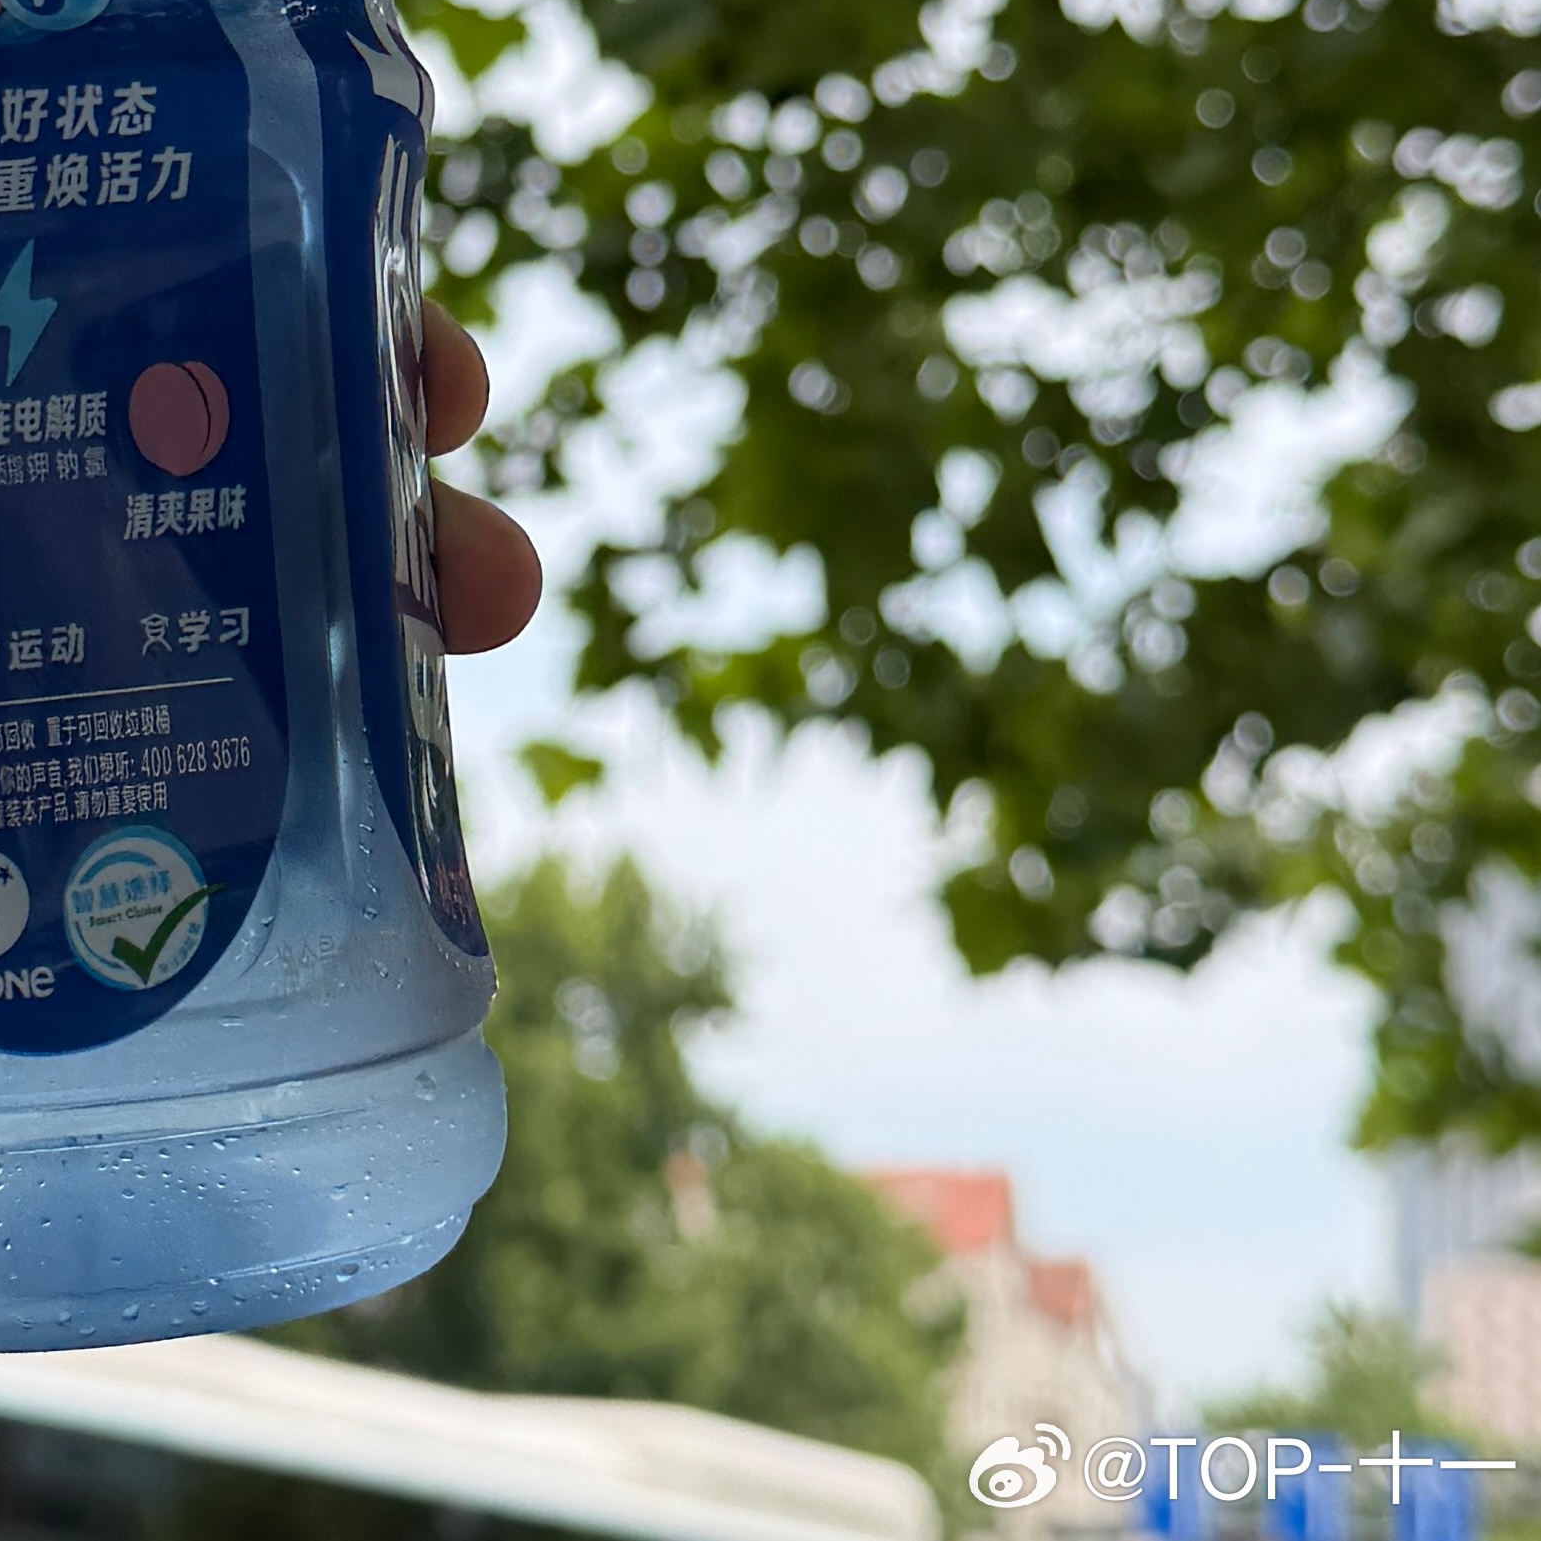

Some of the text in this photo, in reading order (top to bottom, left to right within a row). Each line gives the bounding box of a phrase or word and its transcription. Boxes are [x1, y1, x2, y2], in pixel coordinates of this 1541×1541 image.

[124, 484, 248, 541] 清爽果味
[9, 623, 86, 671] 运动
[178, 606, 250, 654] 学习
[212, 736, 251, 769] 3676
